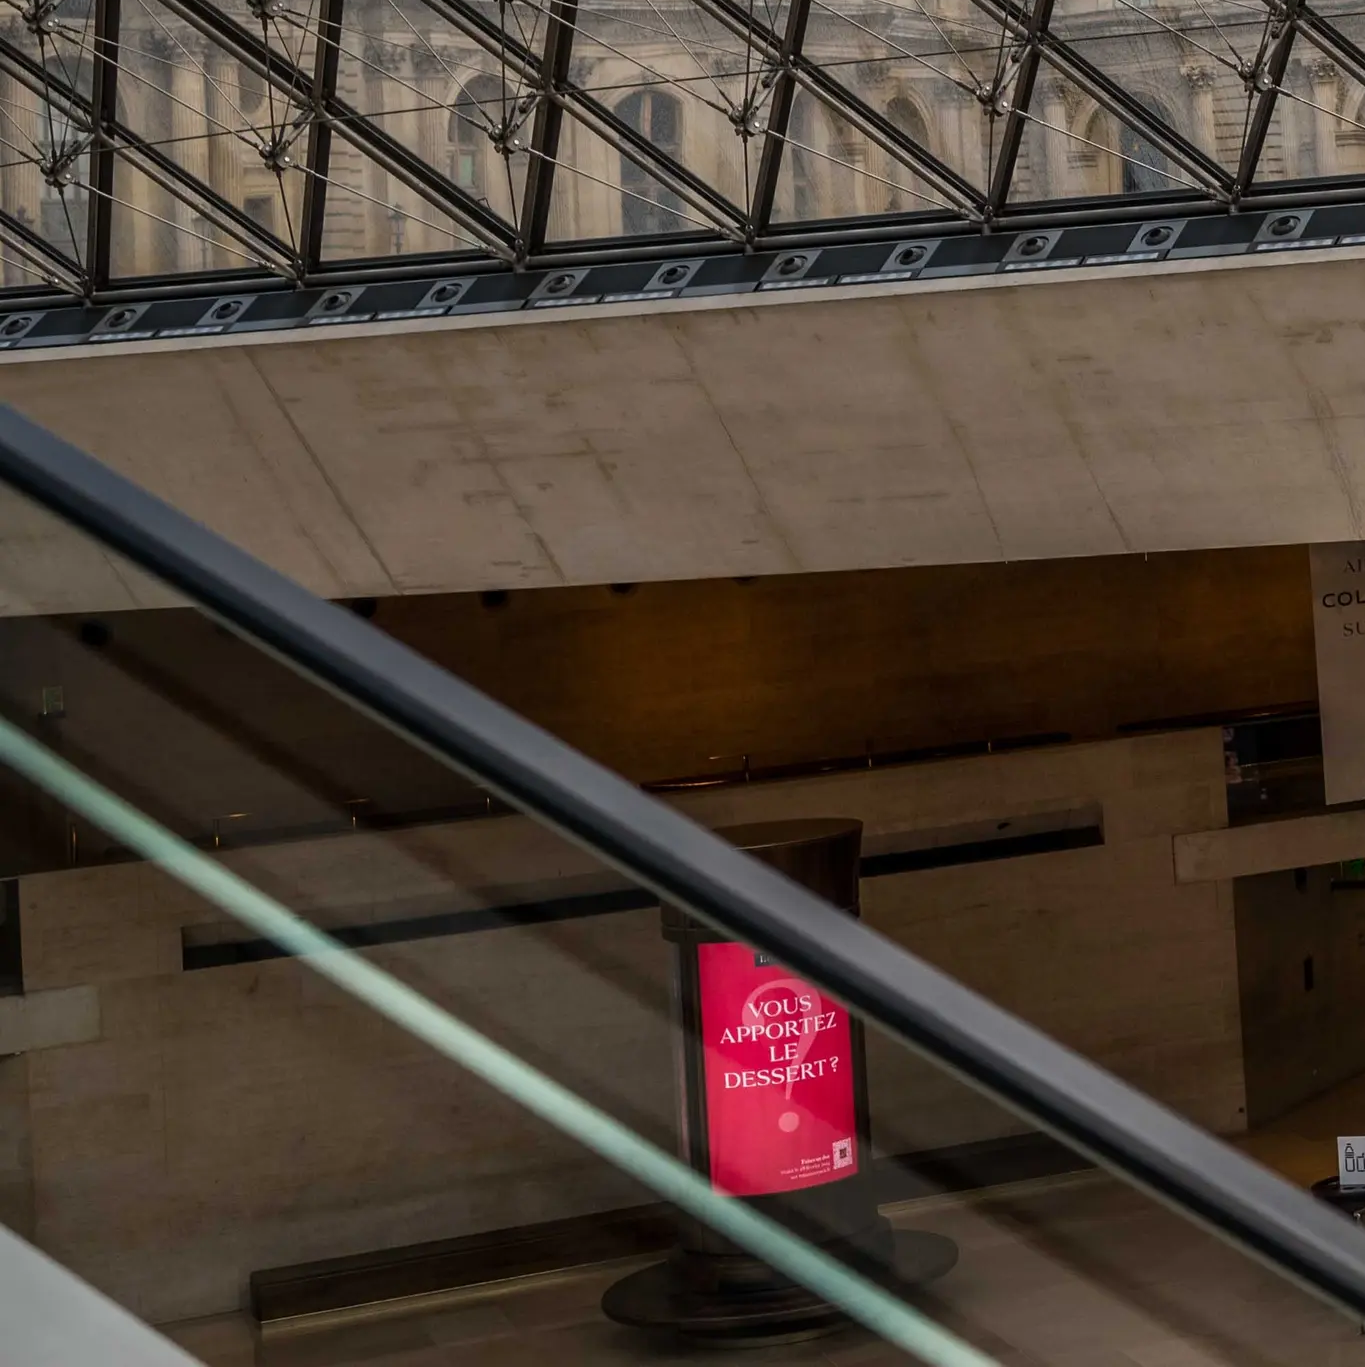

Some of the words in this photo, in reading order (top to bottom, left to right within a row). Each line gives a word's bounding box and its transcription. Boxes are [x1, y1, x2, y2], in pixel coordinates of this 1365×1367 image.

[748, 995, 812, 1019] VOUS
[720, 1011, 837, 1044] APPORTEZ
[769, 1042, 799, 1063] LE
